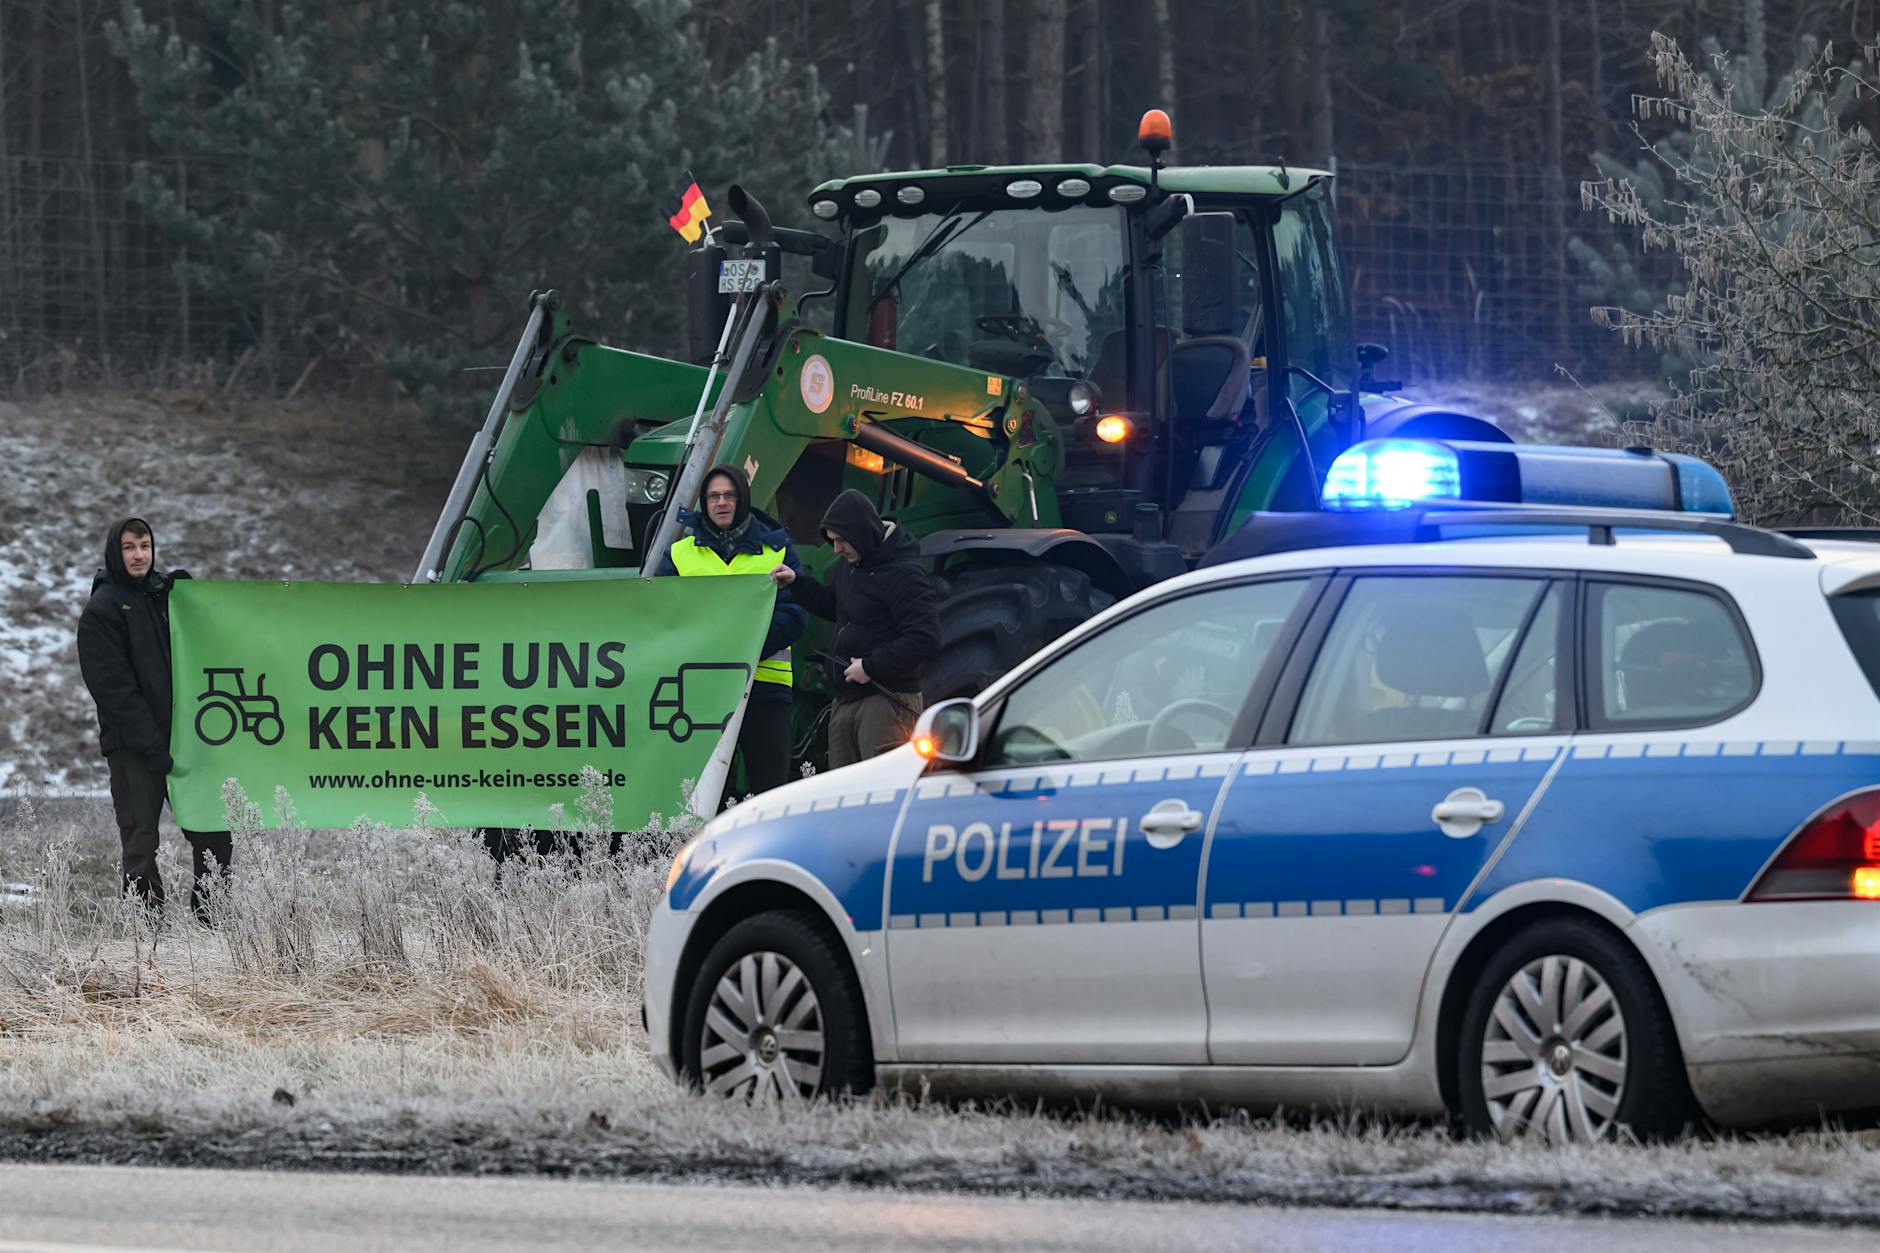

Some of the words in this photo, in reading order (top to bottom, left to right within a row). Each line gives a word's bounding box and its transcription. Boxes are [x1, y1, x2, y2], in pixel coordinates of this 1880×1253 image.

[850, 383, 889, 404] ProfiLine
[890, 391, 904, 407] FZ
[905, 394, 924, 410] 60.1
[308, 643, 480, 691] OHNE
[502, 641, 626, 689] UNS
[309, 705, 439, 749] KEIN
[461, 704, 626, 749] ESSEN
[309, 769, 626, 788] www.ohne-uns-kein-esse.de
[922, 817, 1128, 883] POLIZEI
